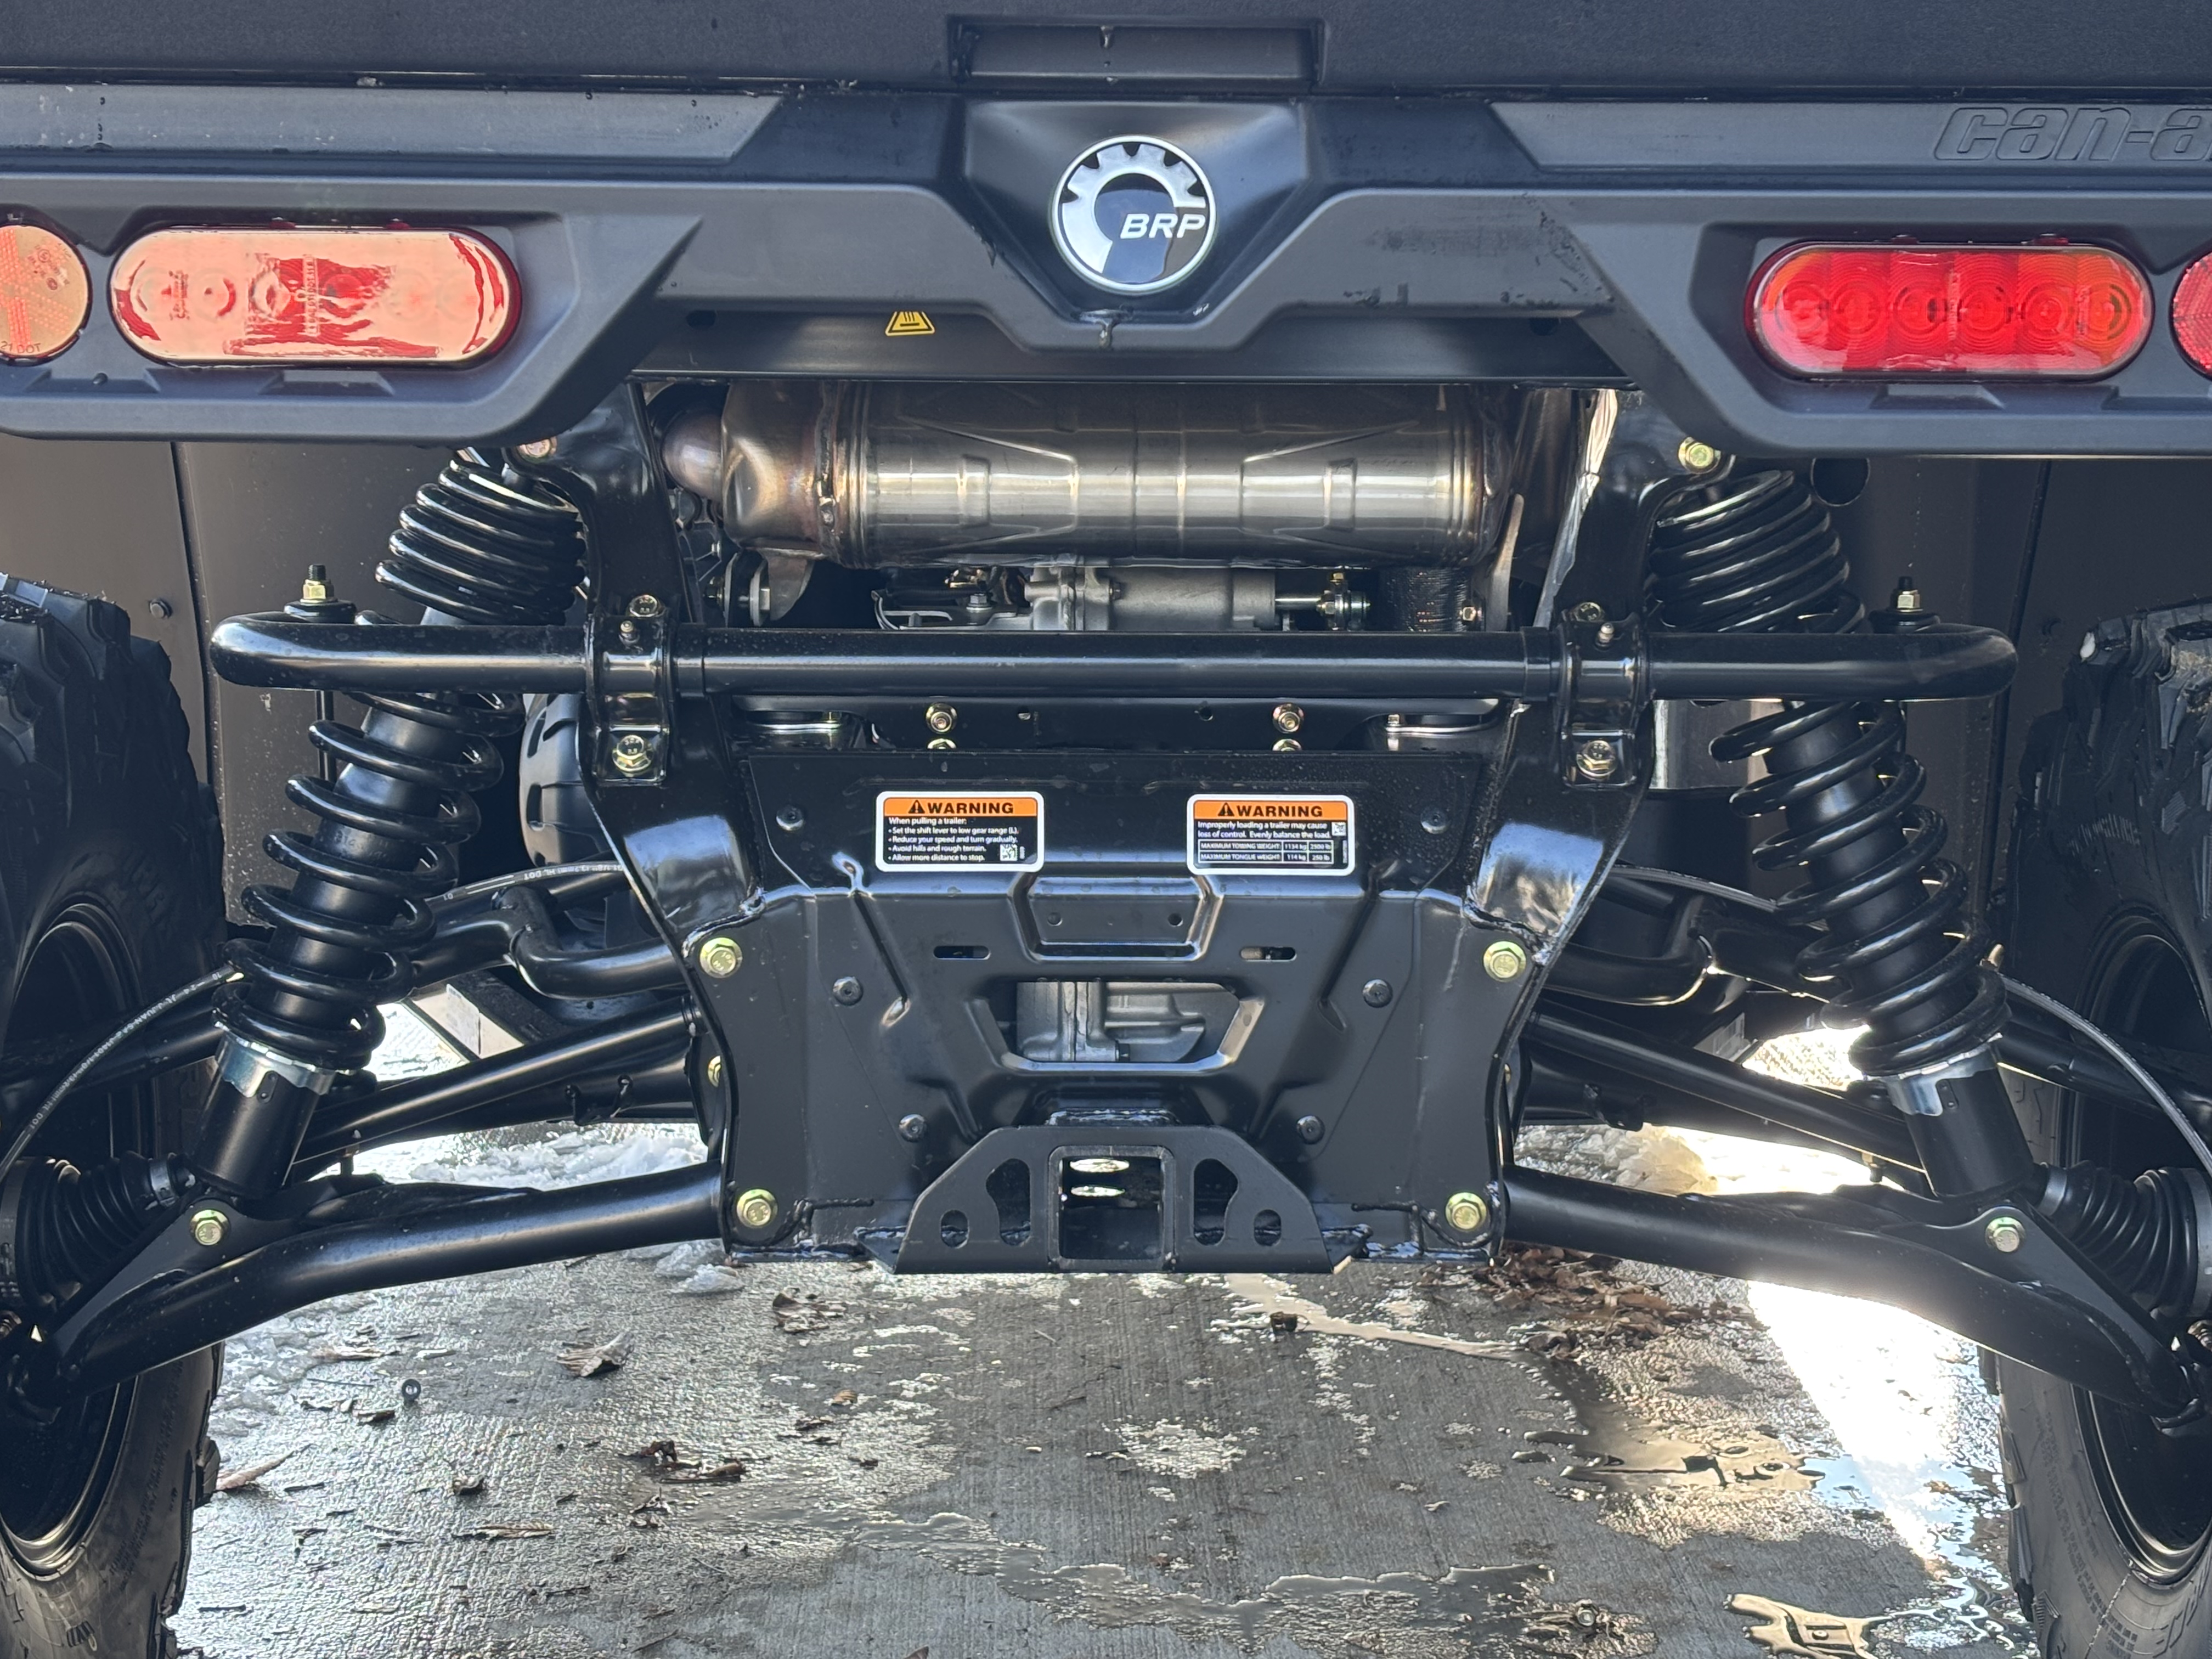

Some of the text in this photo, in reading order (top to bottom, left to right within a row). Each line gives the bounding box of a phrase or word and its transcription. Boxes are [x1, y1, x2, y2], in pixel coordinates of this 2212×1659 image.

[1934, 106, 2212, 161] can-a
[1120, 213, 1206, 239] BRP
[17, 342, 41, 353] DOT
[928, 803, 1014, 814] WARNING
[1237, 806, 1323, 817] WARNING
[911, 817, 936, 826] pulling
[1198, 821, 1236, 830] Improperly
[1237, 821, 1263, 830] loading
[935, 836, 955, 844] speed
[985, 836, 1018, 844] gradually.
[1249, 831, 1272, 839] Evenly
[941, 844, 962, 854] rough
[968, 854, 985, 862] stop.
[524, 870, 542, 880] DOT
